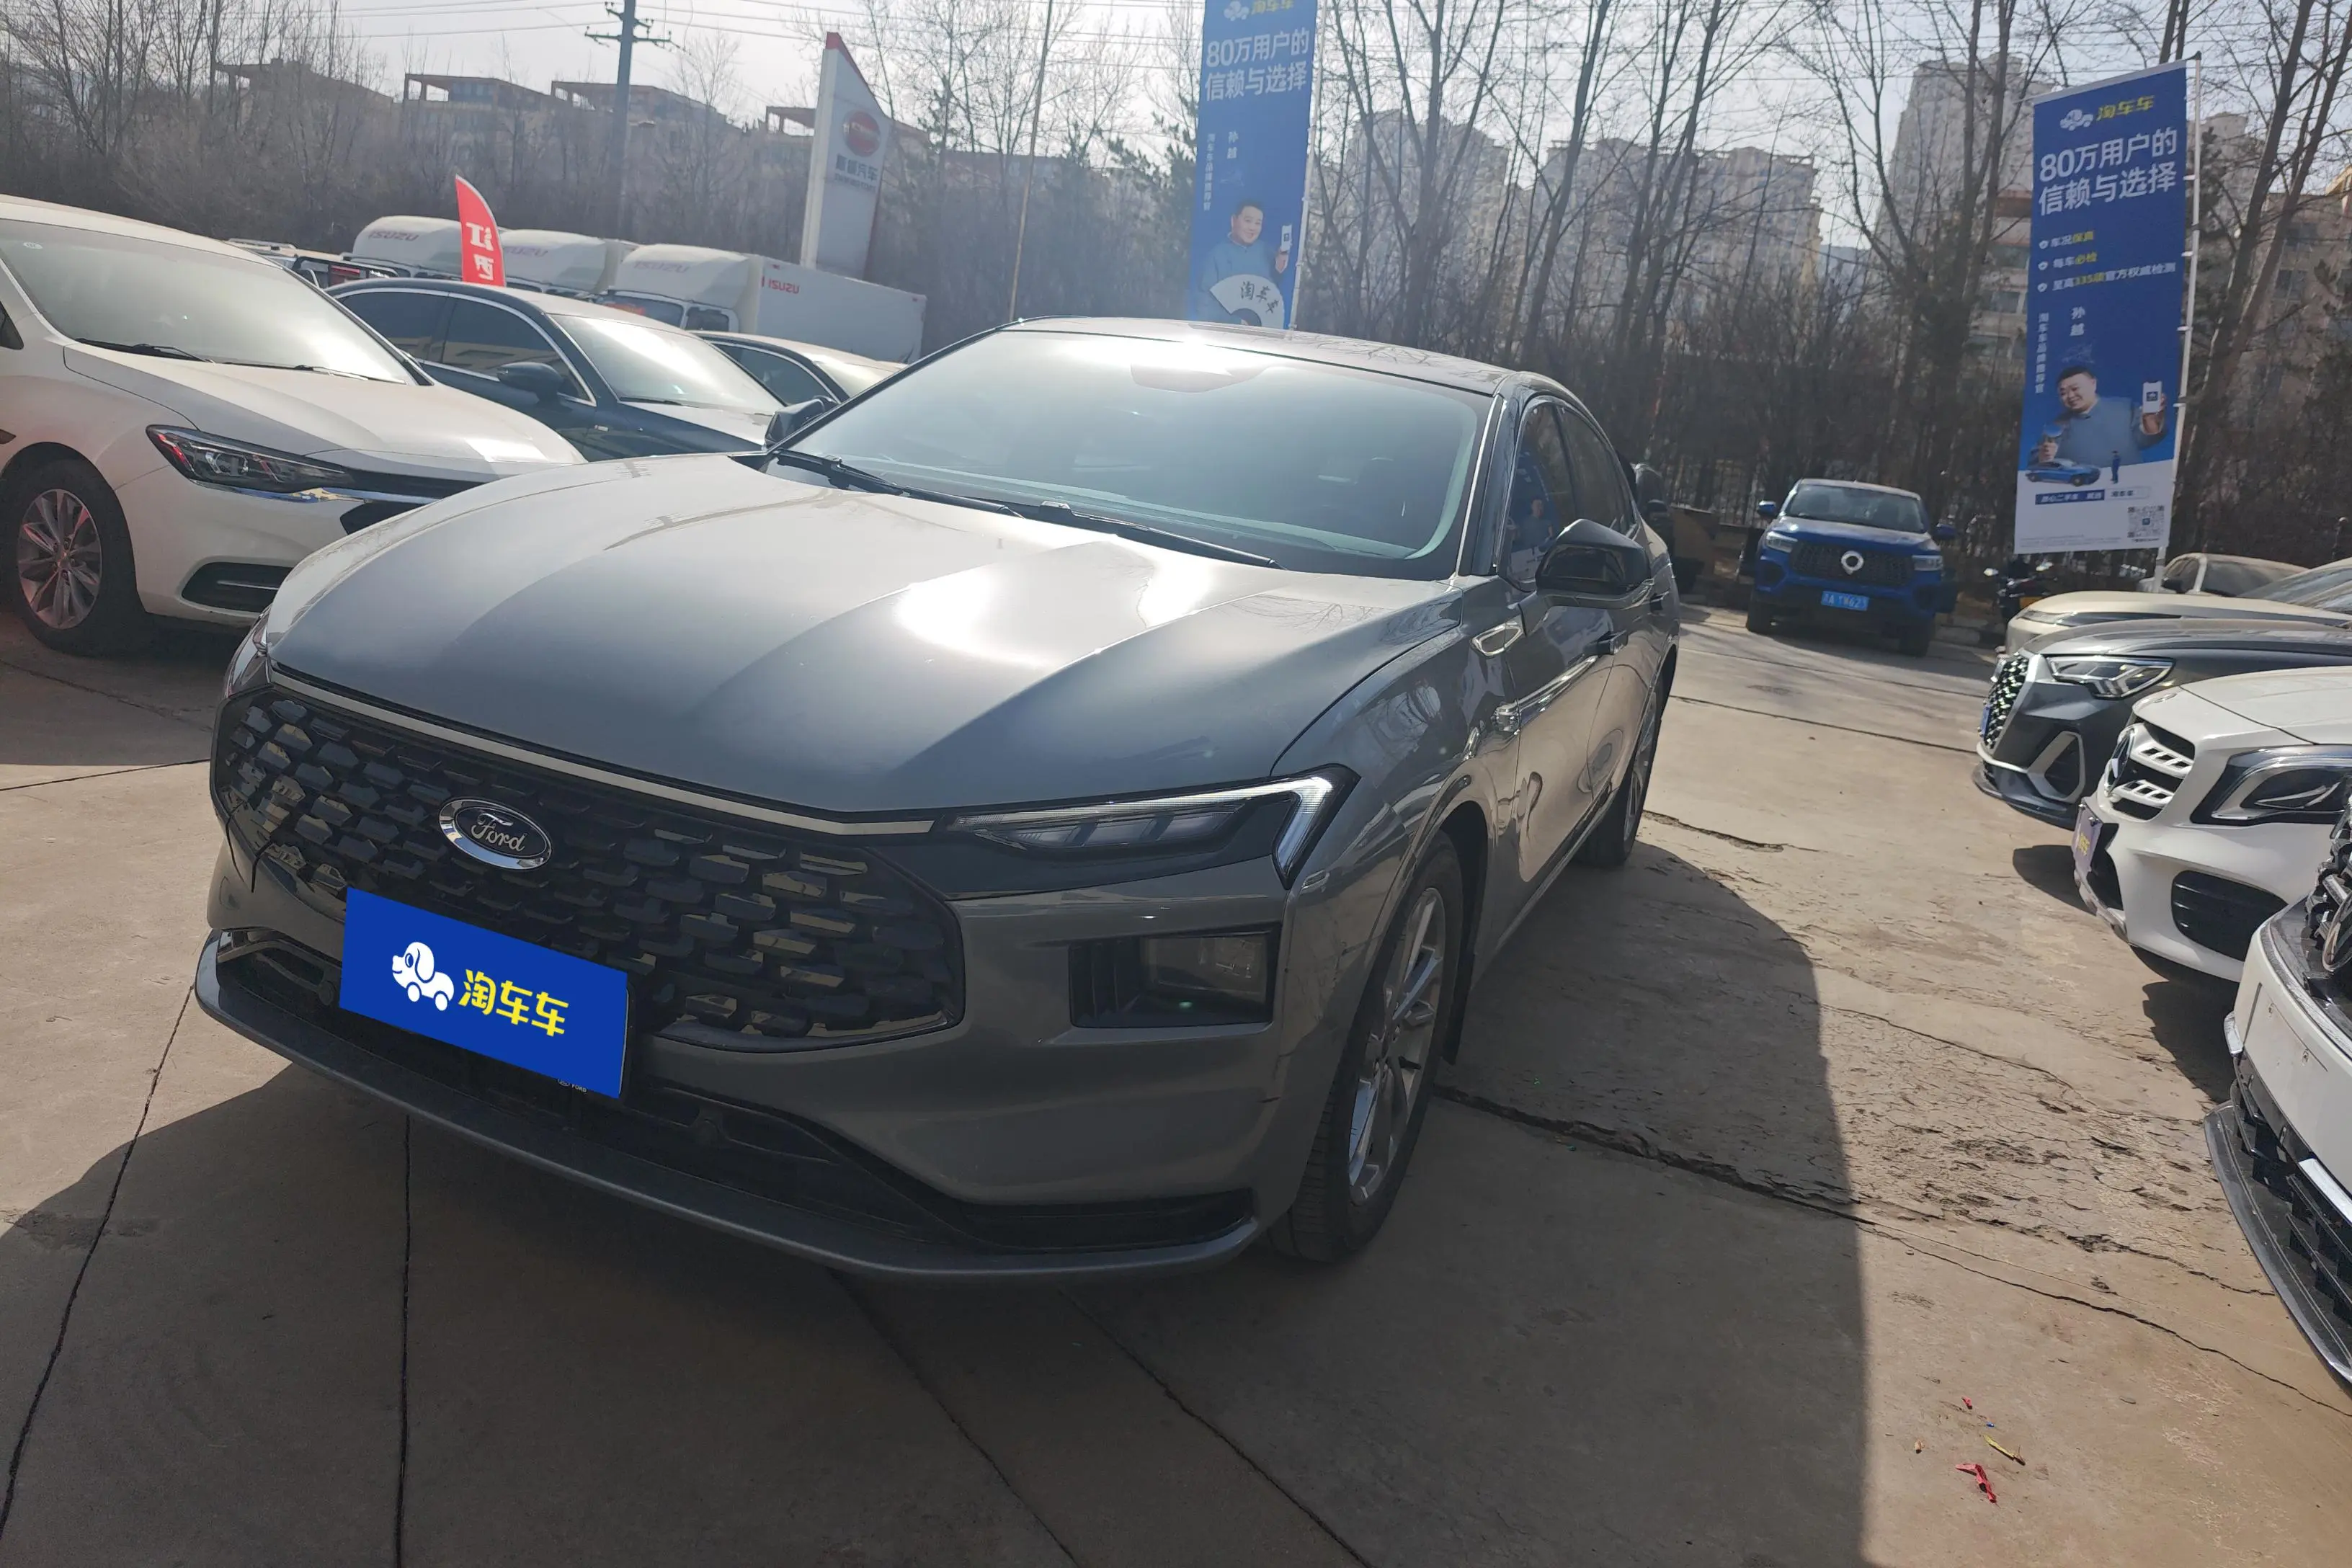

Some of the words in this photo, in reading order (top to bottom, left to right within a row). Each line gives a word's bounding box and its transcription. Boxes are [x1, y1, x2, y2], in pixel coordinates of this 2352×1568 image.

[1206, 27, 1310, 67] 80万用户的
[1205, 61, 1307, 102] 信赖与选择
[2096, 95, 2155, 121] 淘车车
[2039, 127, 2177, 182] 80万用户的
[2039, 161, 2176, 216] 信赖与选择
[368, 230, 419, 242] ISUZU
[633, 261, 690, 274] ISUZU
[769, 277, 801, 295] ISUZU
[2070, 306, 2085, 337] 孙越
[471, 812, 526, 852] Ford
[571, 1083, 587, 1093] FORD
